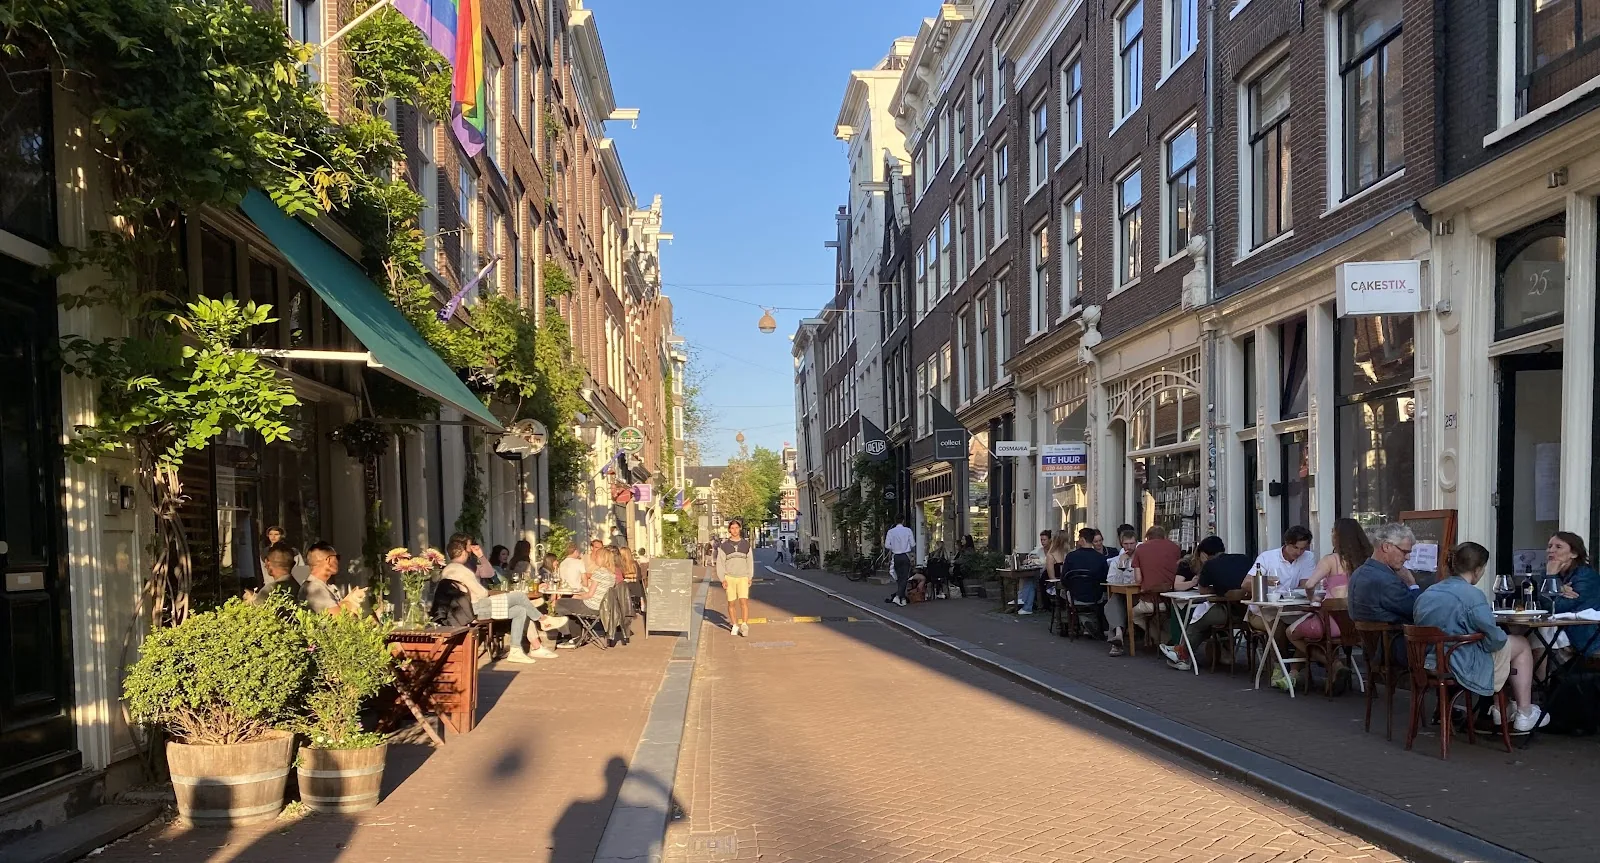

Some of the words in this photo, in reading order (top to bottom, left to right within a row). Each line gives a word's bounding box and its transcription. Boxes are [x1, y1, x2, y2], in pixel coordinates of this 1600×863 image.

[1350, 279, 1406, 293] CAKESTIX
[1528, 269, 1550, 296] 25
[867, 441, 884, 453] DEUS
[940, 439, 961, 447] collect
[1046, 456, 1057, 464] TE
[1057, 455, 1081, 464] HUUR
